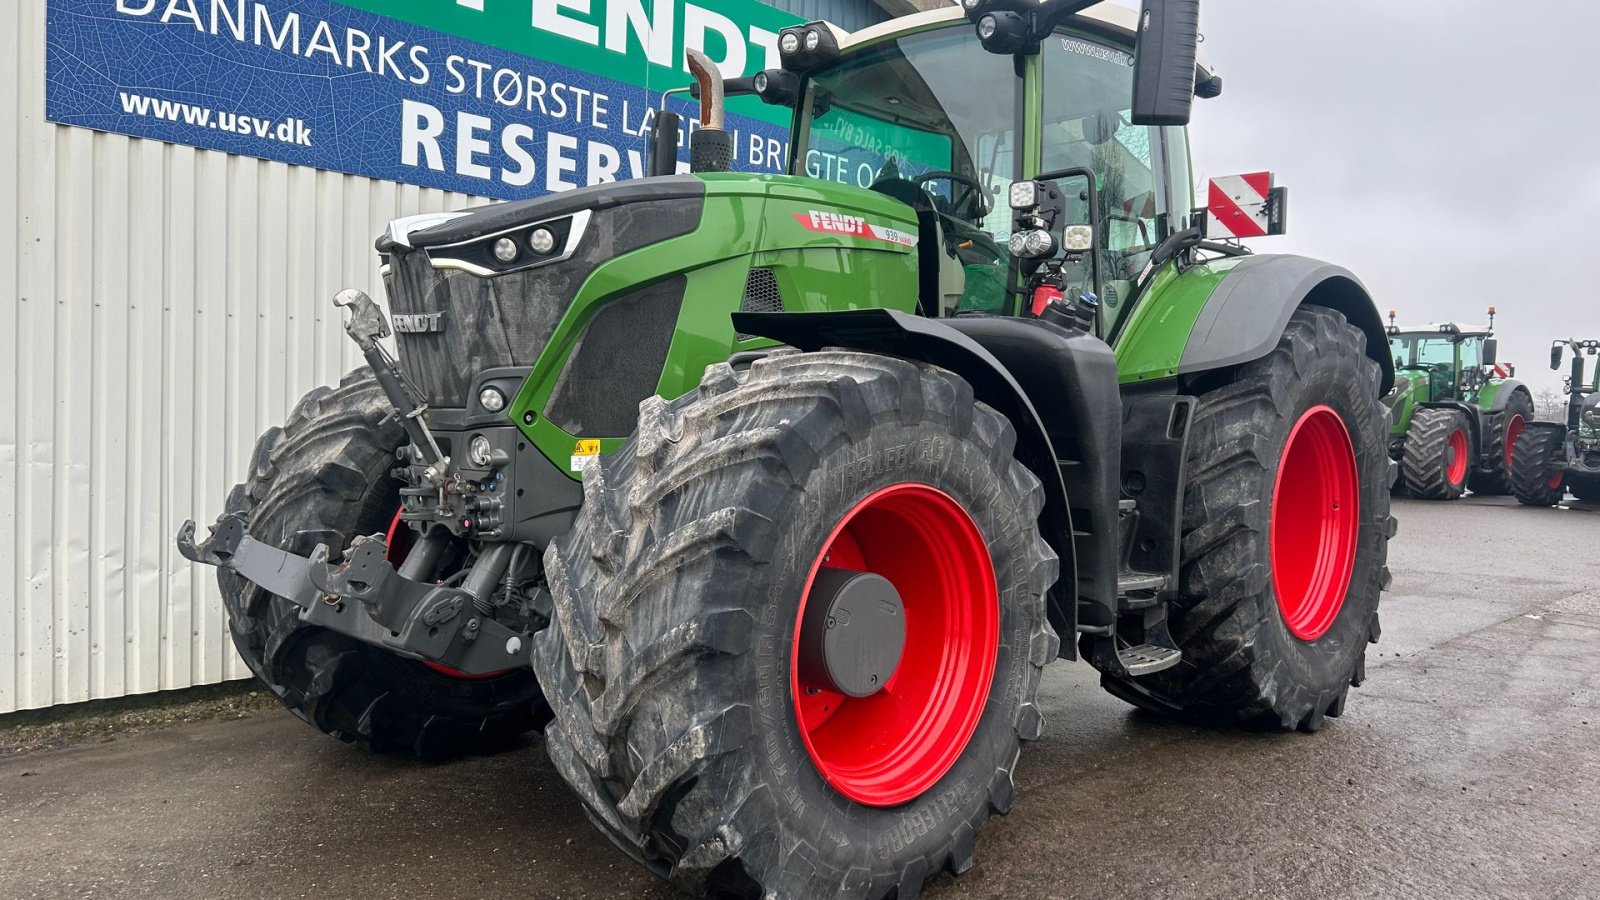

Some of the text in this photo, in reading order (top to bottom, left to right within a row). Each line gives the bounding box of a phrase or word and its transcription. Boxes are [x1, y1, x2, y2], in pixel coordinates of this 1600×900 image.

[455, 0, 784, 80] ENDT
[119, 92, 312, 147] www.usv.dk
[400, 98, 691, 192] RESER
[445, 55, 609, 129] STØRSTE
[622, 99, 701, 150] LAG
[732, 129, 740, 161] I
[749, 133, 848, 184] BRGTE
[857, 162, 882, 189] O
[808, 209, 865, 233] FENDT
[885, 229, 898, 242] 939
[392, 312, 442, 333] FENDT
